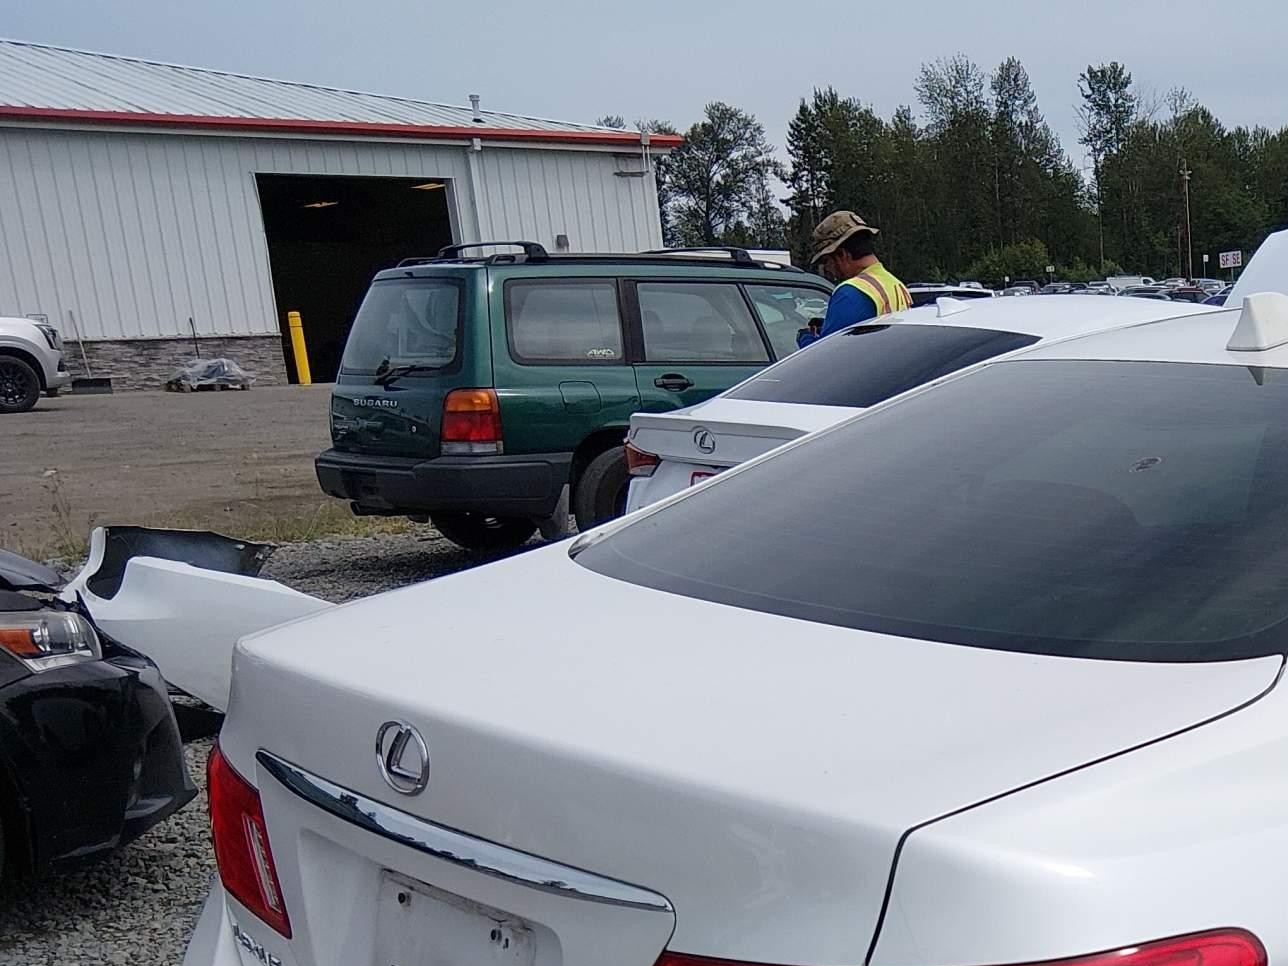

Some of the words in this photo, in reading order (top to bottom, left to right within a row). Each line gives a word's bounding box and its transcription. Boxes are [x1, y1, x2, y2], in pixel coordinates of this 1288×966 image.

[1221, 254, 1230, 266] SF
[1232, 252, 1241, 265] SE
[353, 398, 398, 408] SUBARU
